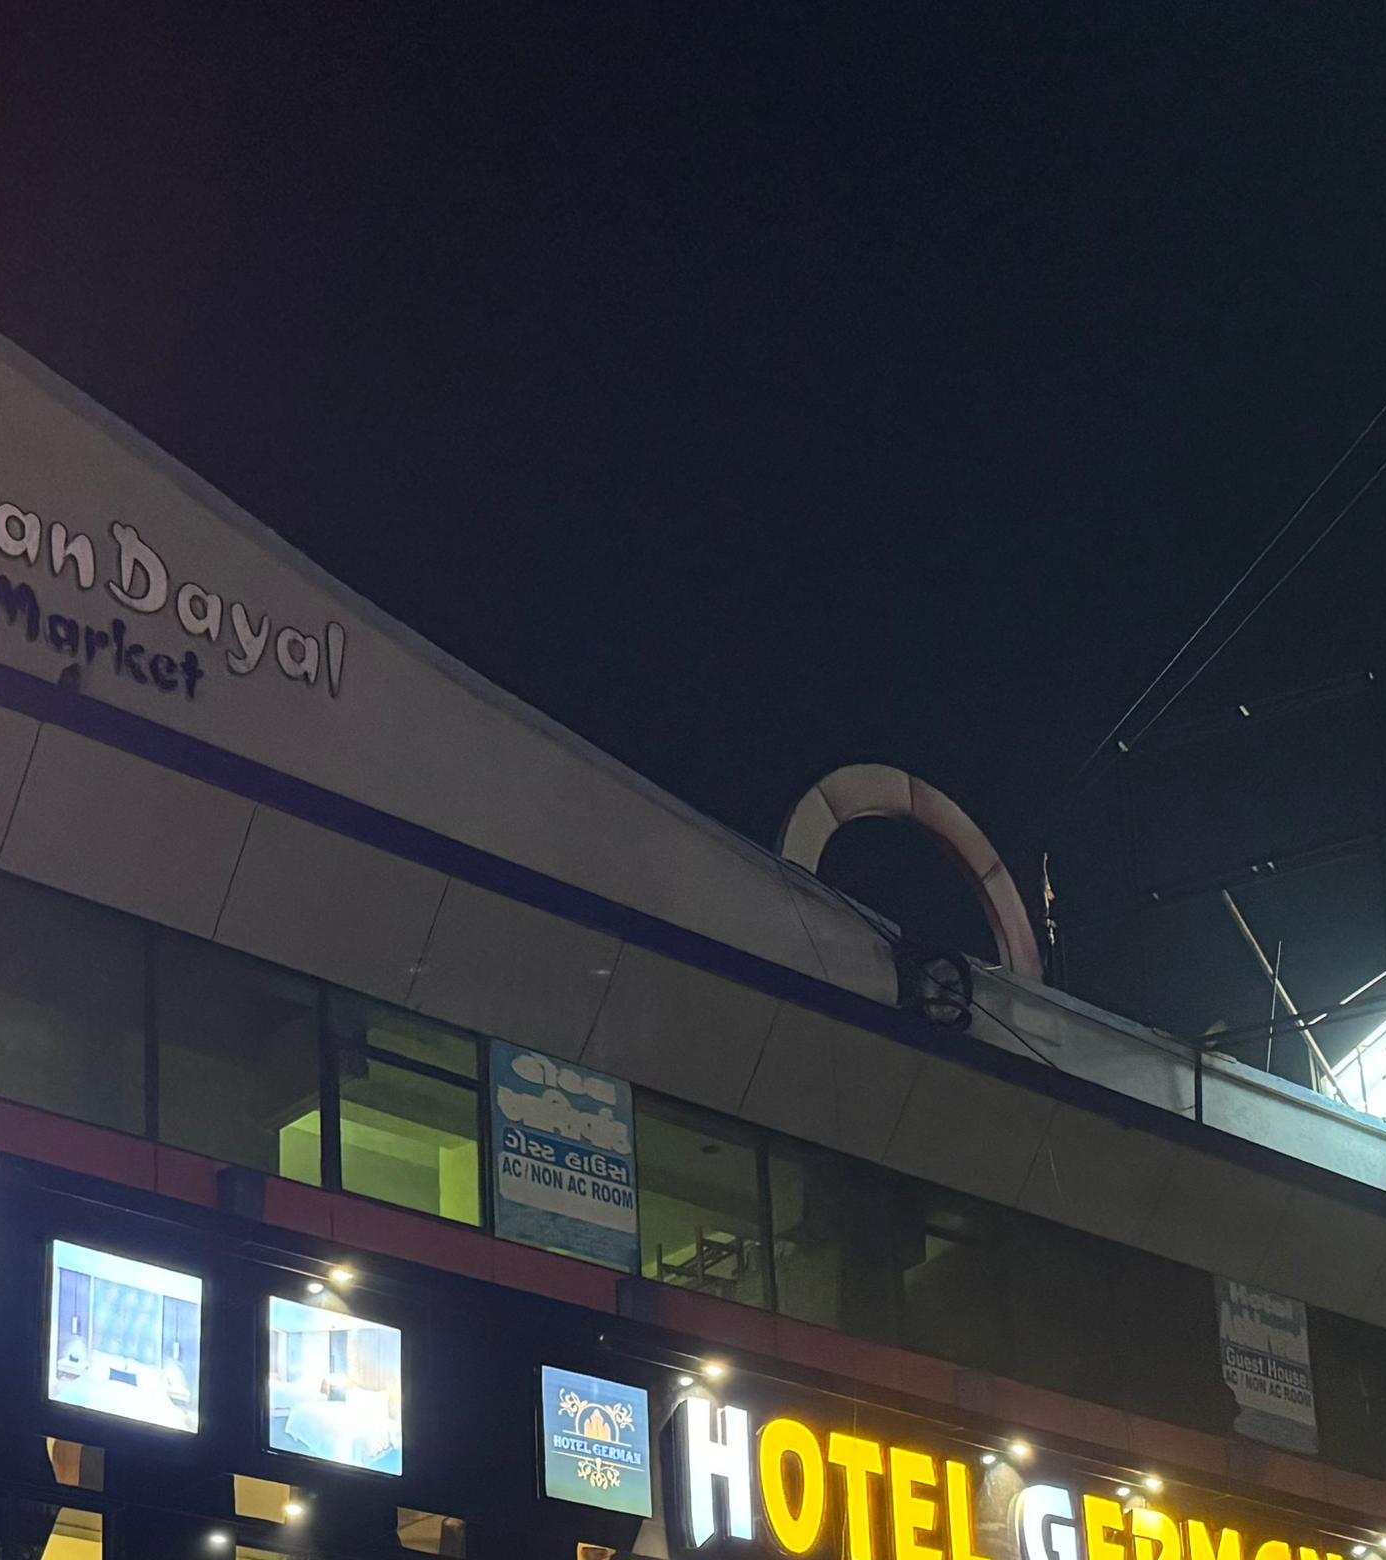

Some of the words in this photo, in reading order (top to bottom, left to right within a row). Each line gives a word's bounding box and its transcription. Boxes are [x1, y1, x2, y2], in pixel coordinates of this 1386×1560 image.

[108, 520, 346, 699] Dayal
[567, 1175, 587, 1196] AC
[591, 1180, 634, 1210] ROOM
[1225, 1346, 1264, 1375] Guest
[1267, 1359, 1308, 1389] House
[553, 1434, 591, 1455] HOTEL
[592, 1443, 642, 1465] GERMAN
